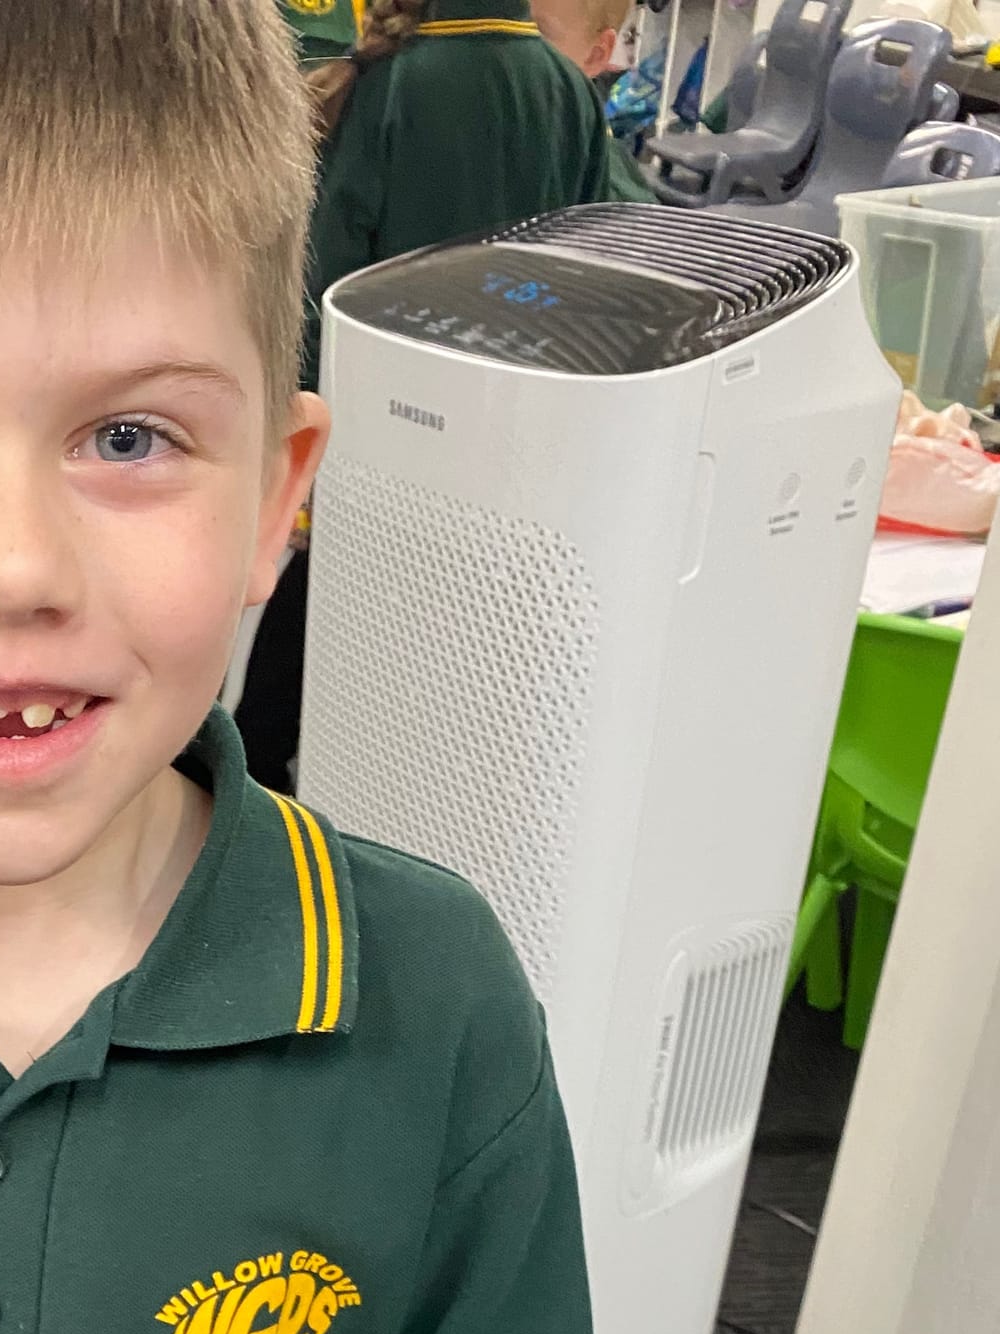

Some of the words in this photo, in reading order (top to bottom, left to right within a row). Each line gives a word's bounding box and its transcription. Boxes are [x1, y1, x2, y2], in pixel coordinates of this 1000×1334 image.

[389, 399, 446, 432] SAMSUNG
[154, 1252, 283, 1326] WILLOW
[289, 1249, 362, 1308] GROVE
